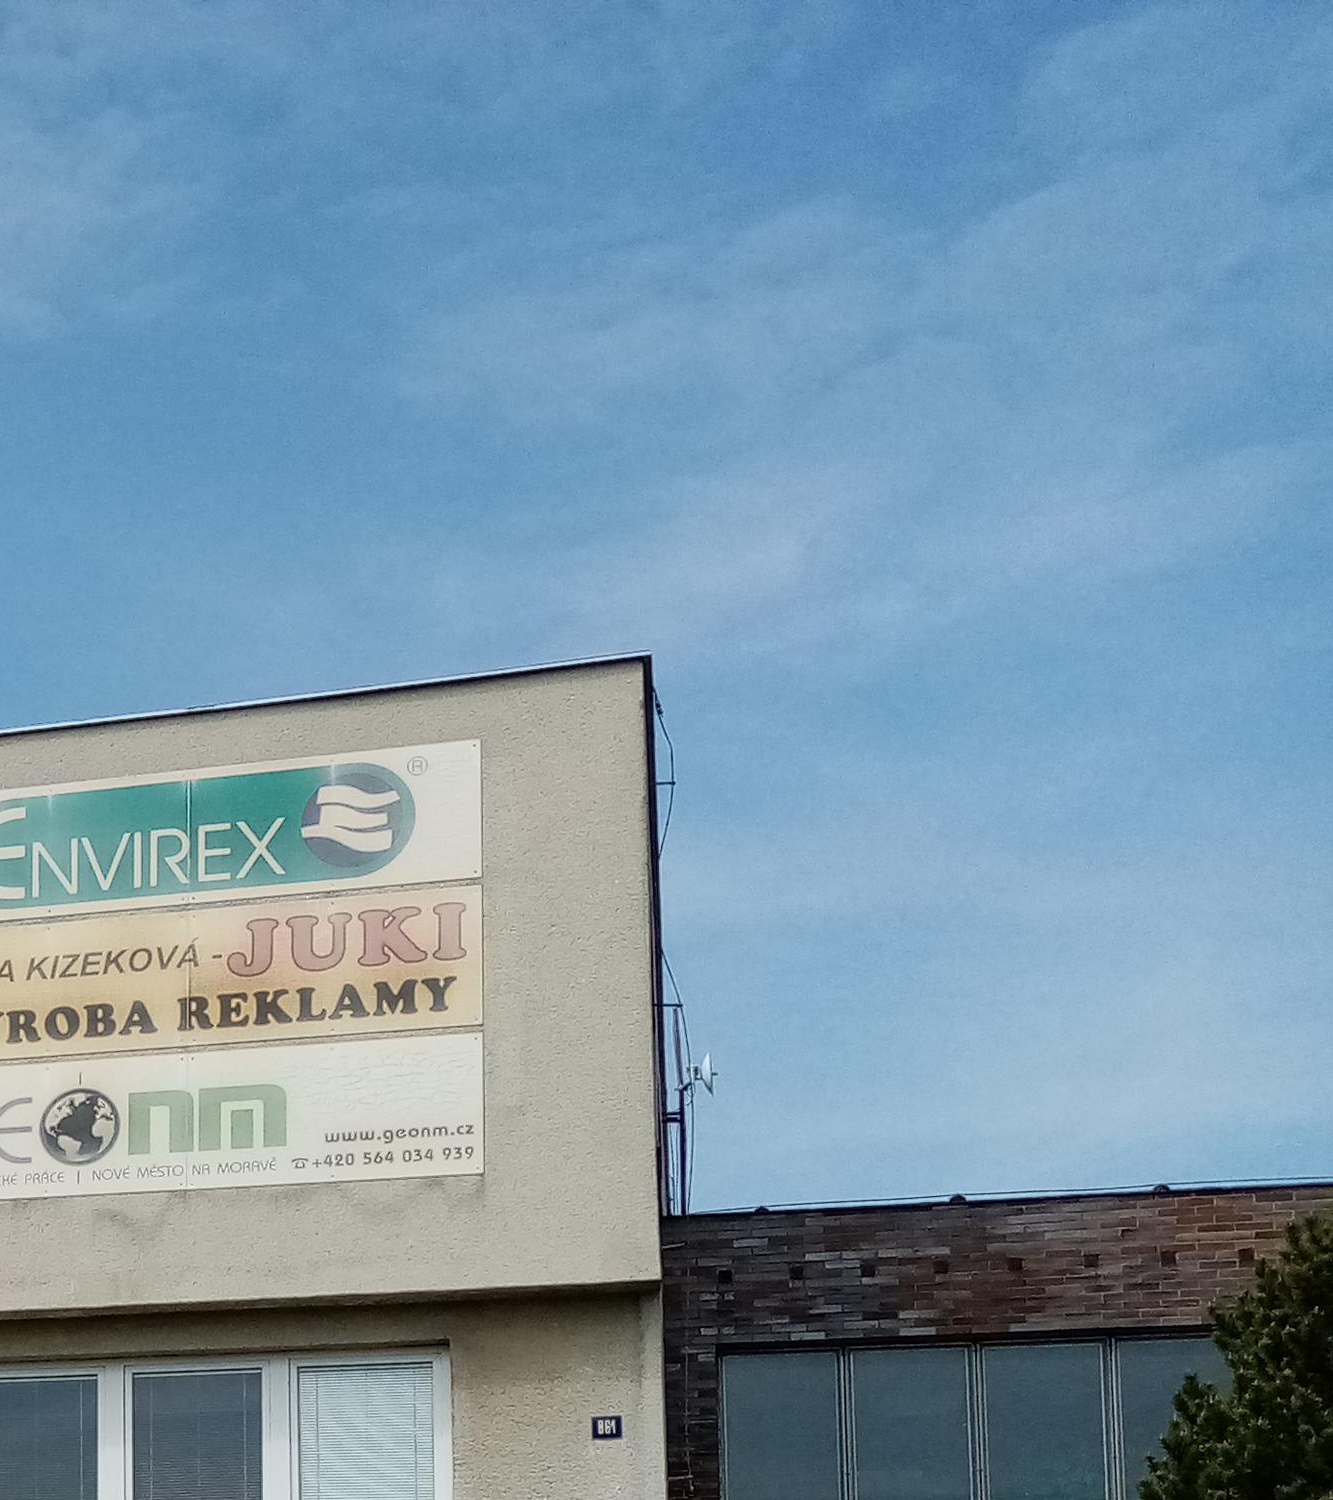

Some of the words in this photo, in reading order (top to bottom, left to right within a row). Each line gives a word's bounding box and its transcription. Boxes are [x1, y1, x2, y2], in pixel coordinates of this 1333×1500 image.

[25, 937, 200, 982] KIZEKOVÁ
[226, 902, 468, 977] JUKI
[176, 976, 457, 1032] REKLAMY
[324, 1123, 475, 1144] www.geonm.cz
[362, 1150, 394, 1165] 564
[402, 1149, 434, 1163] 034
[442, 1146, 474, 1161] 939
[24, 1171, 66, 1185] PRÁCE
[91, 1165, 131, 1181] NOVÉ
[191, 1162, 211, 1176] NA
[216, 1156, 278, 1174] MORAVĚ
[596, 1418, 617, 1435] 861
